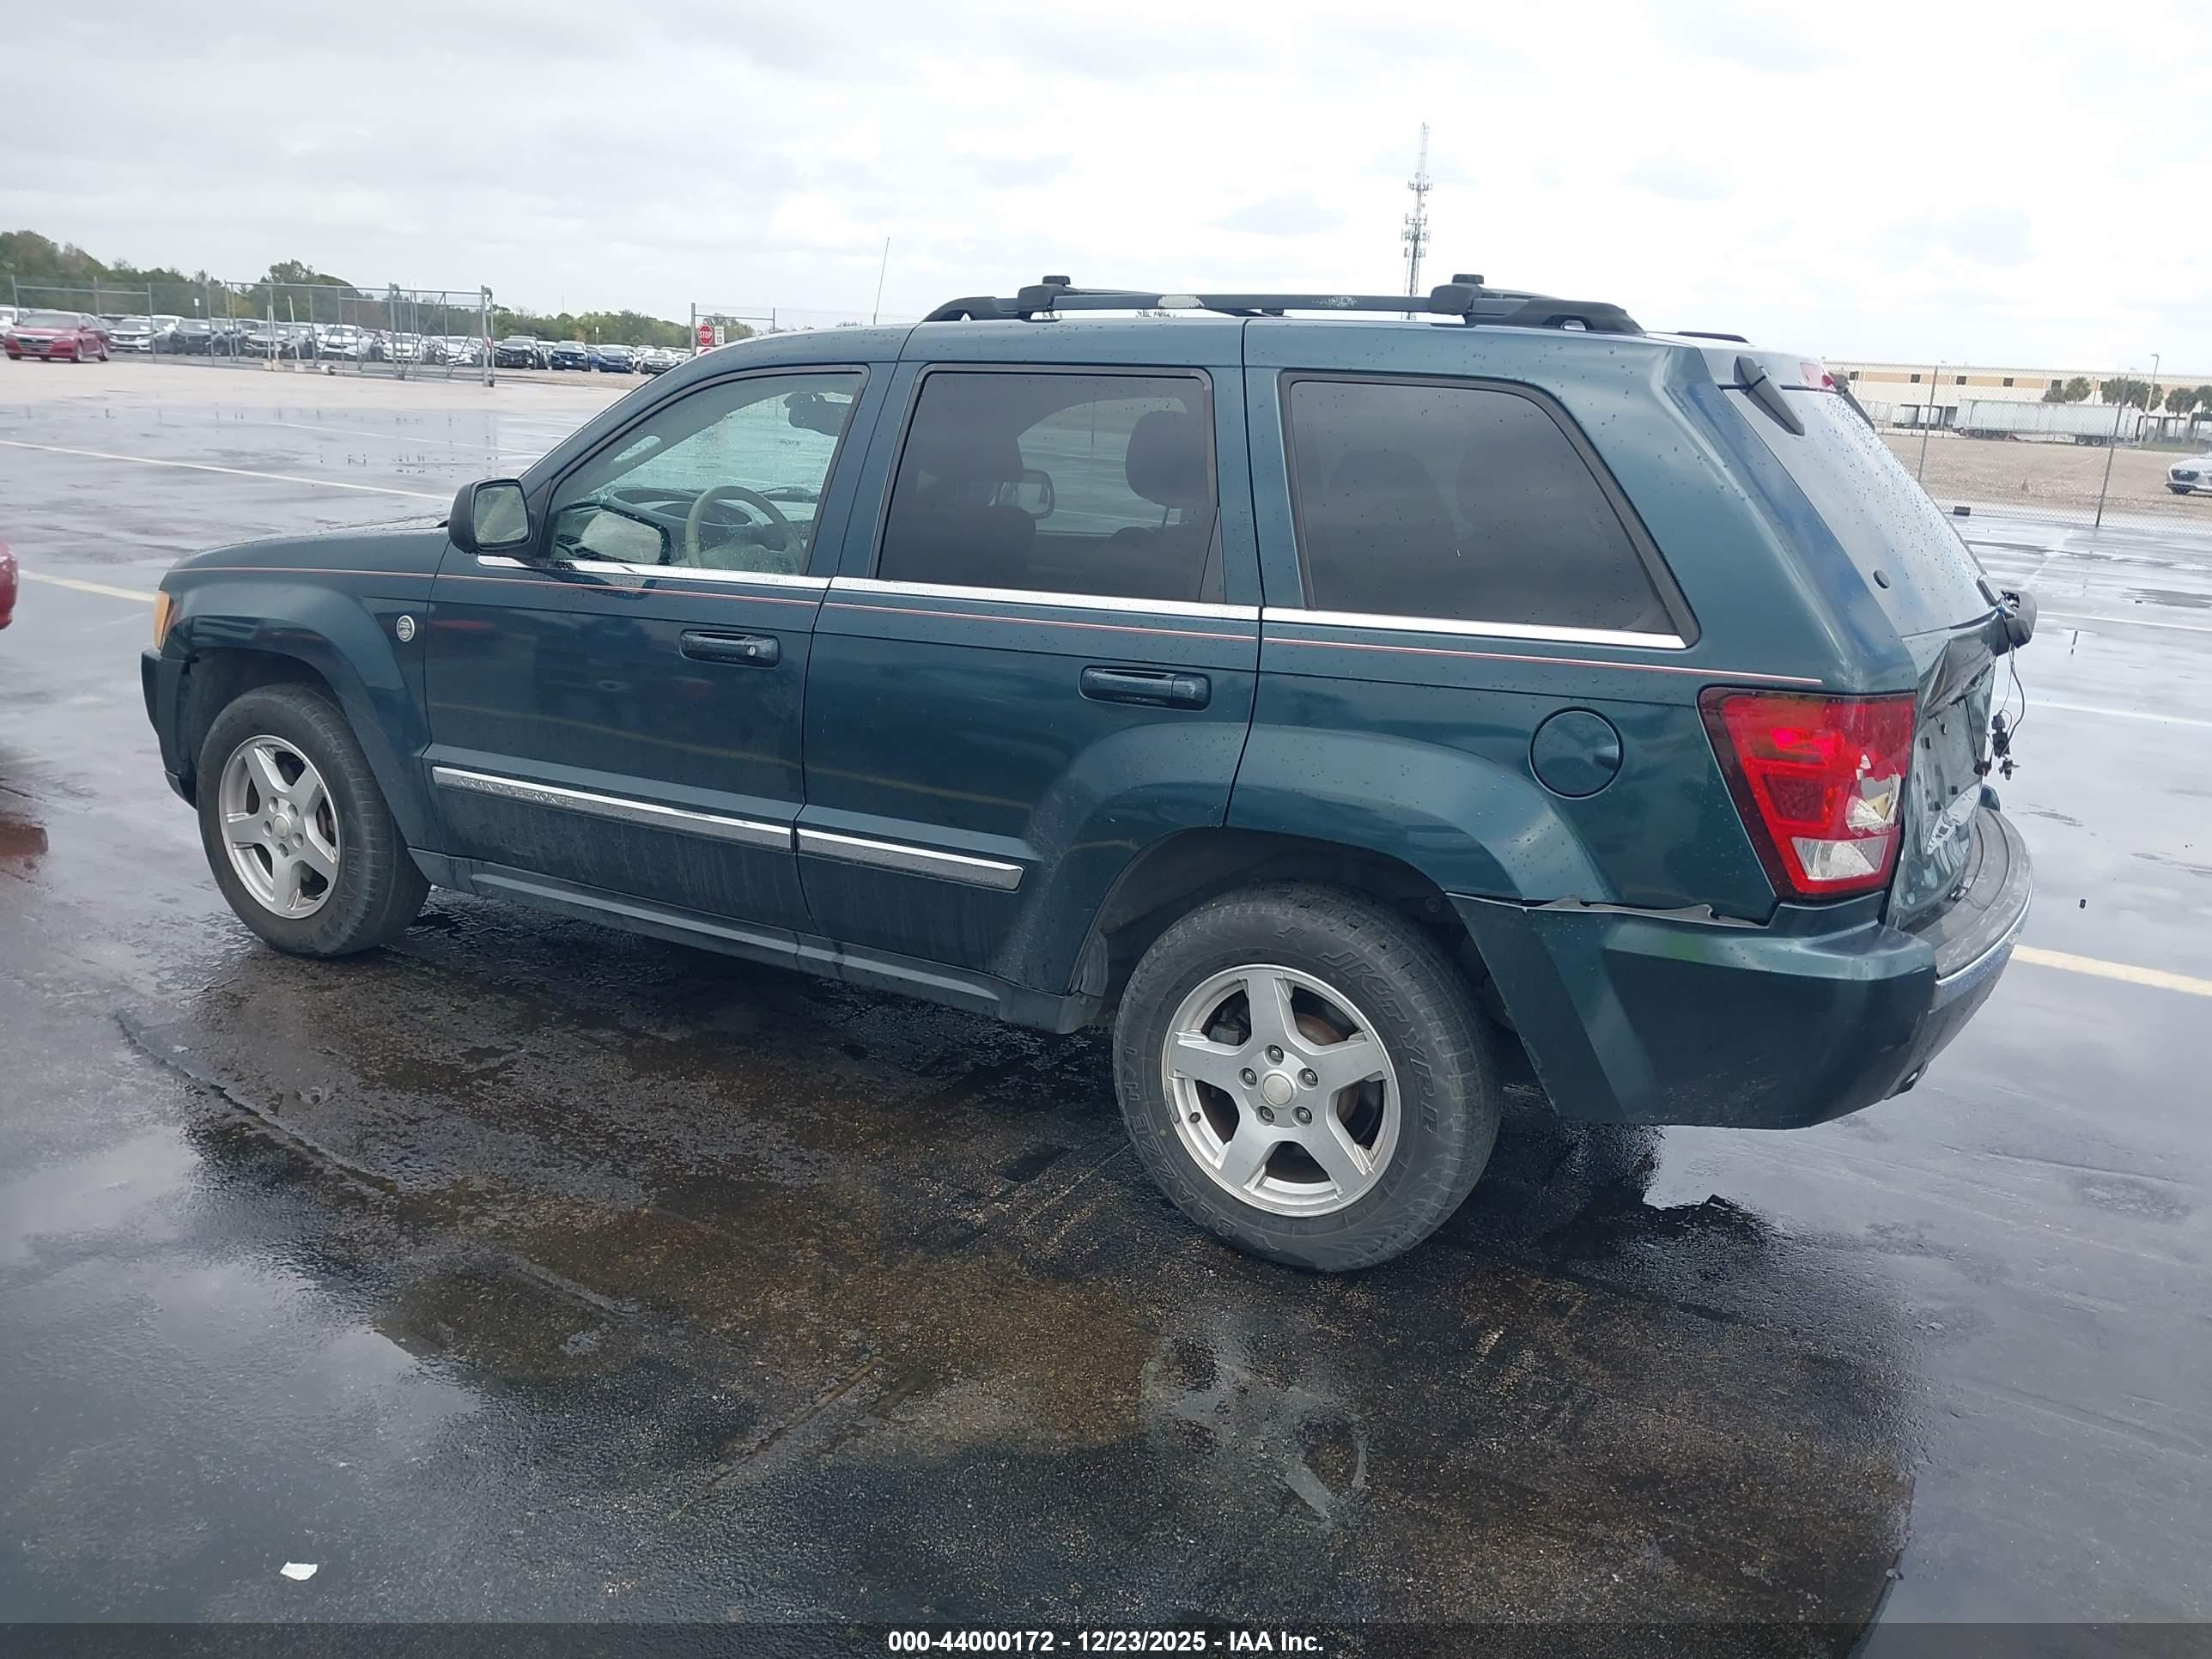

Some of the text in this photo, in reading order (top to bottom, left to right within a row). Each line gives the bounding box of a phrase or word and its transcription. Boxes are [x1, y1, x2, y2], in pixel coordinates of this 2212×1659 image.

[699, 331, 713, 339] STOP
[459, 776, 575, 807] GRAND CHEROKEE
